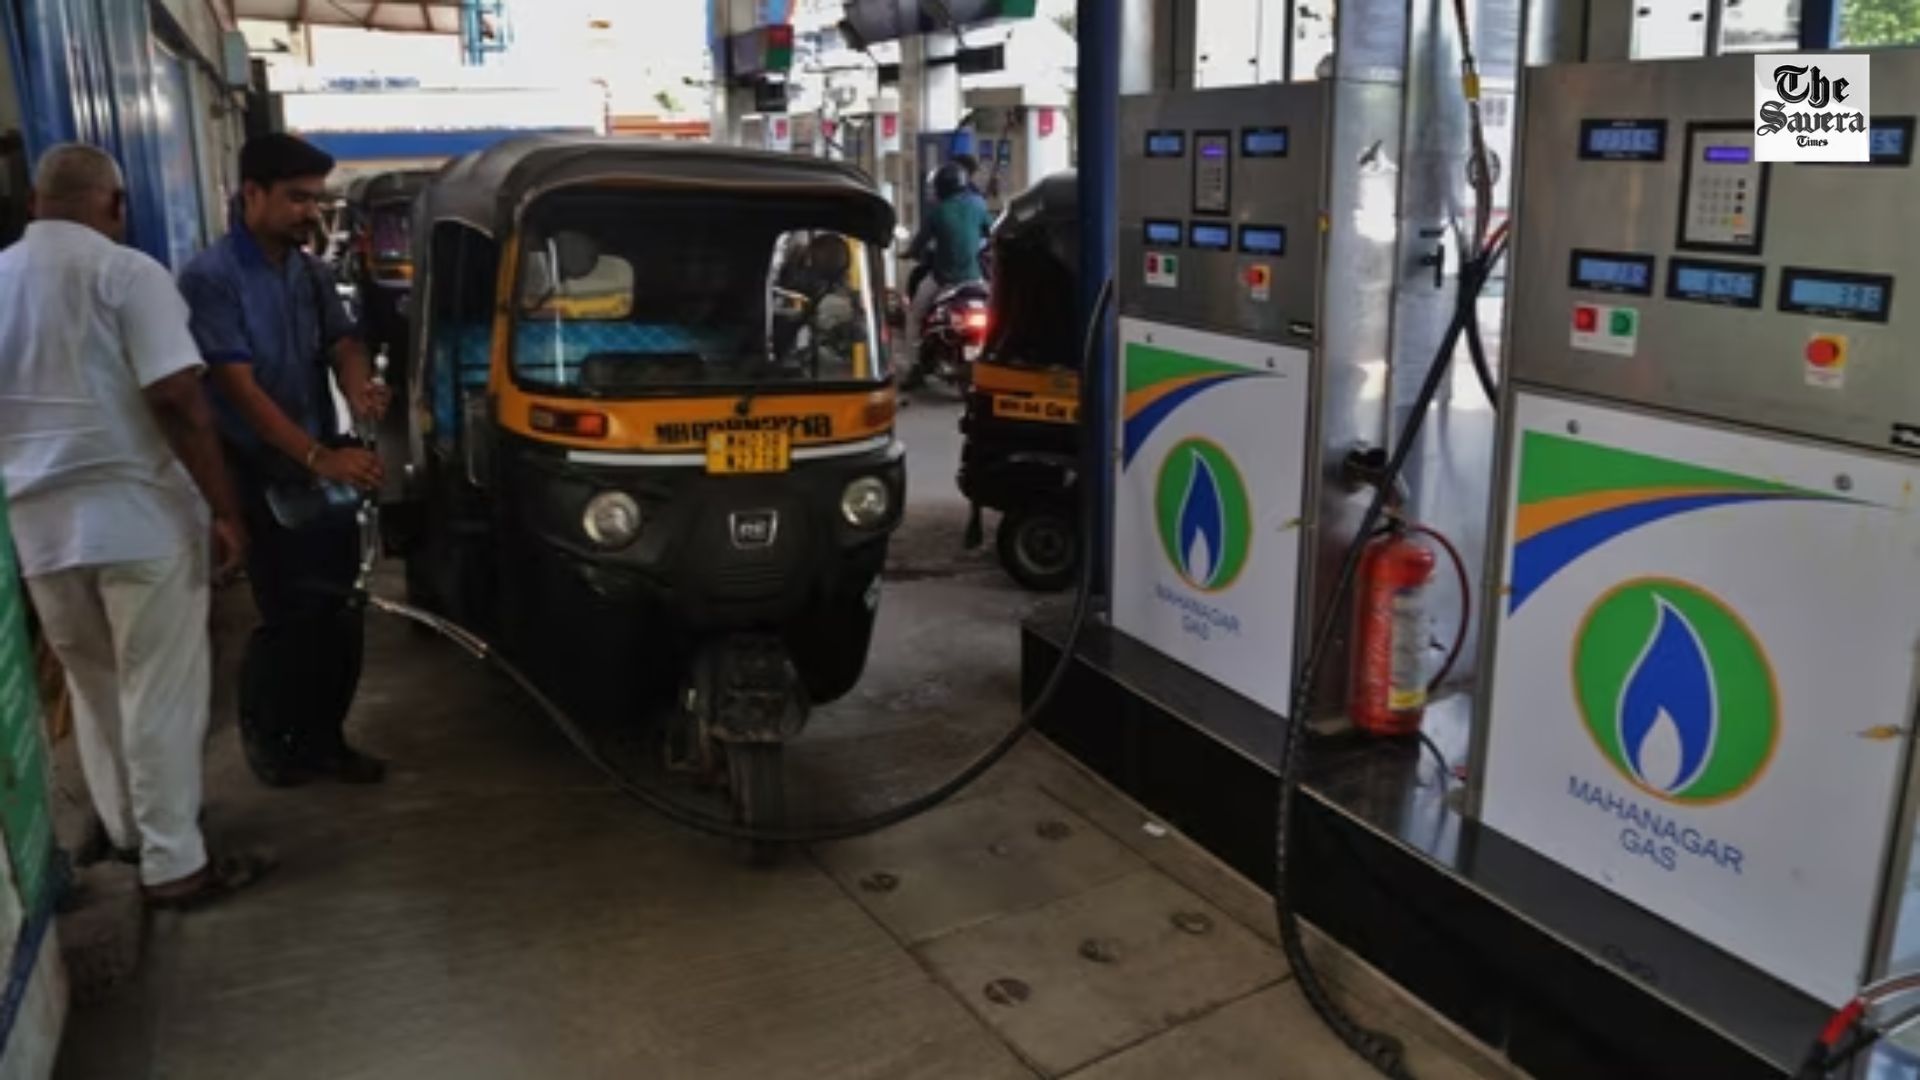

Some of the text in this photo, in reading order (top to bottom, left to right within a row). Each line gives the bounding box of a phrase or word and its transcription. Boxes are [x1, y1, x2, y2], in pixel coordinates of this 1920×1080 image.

[1155, 582, 1241, 633] MAHANAGAR
[1182, 614, 1210, 641] GAS
[1568, 775, 1743, 874] MAHANAGAR
[1619, 827, 1677, 872] GAS
